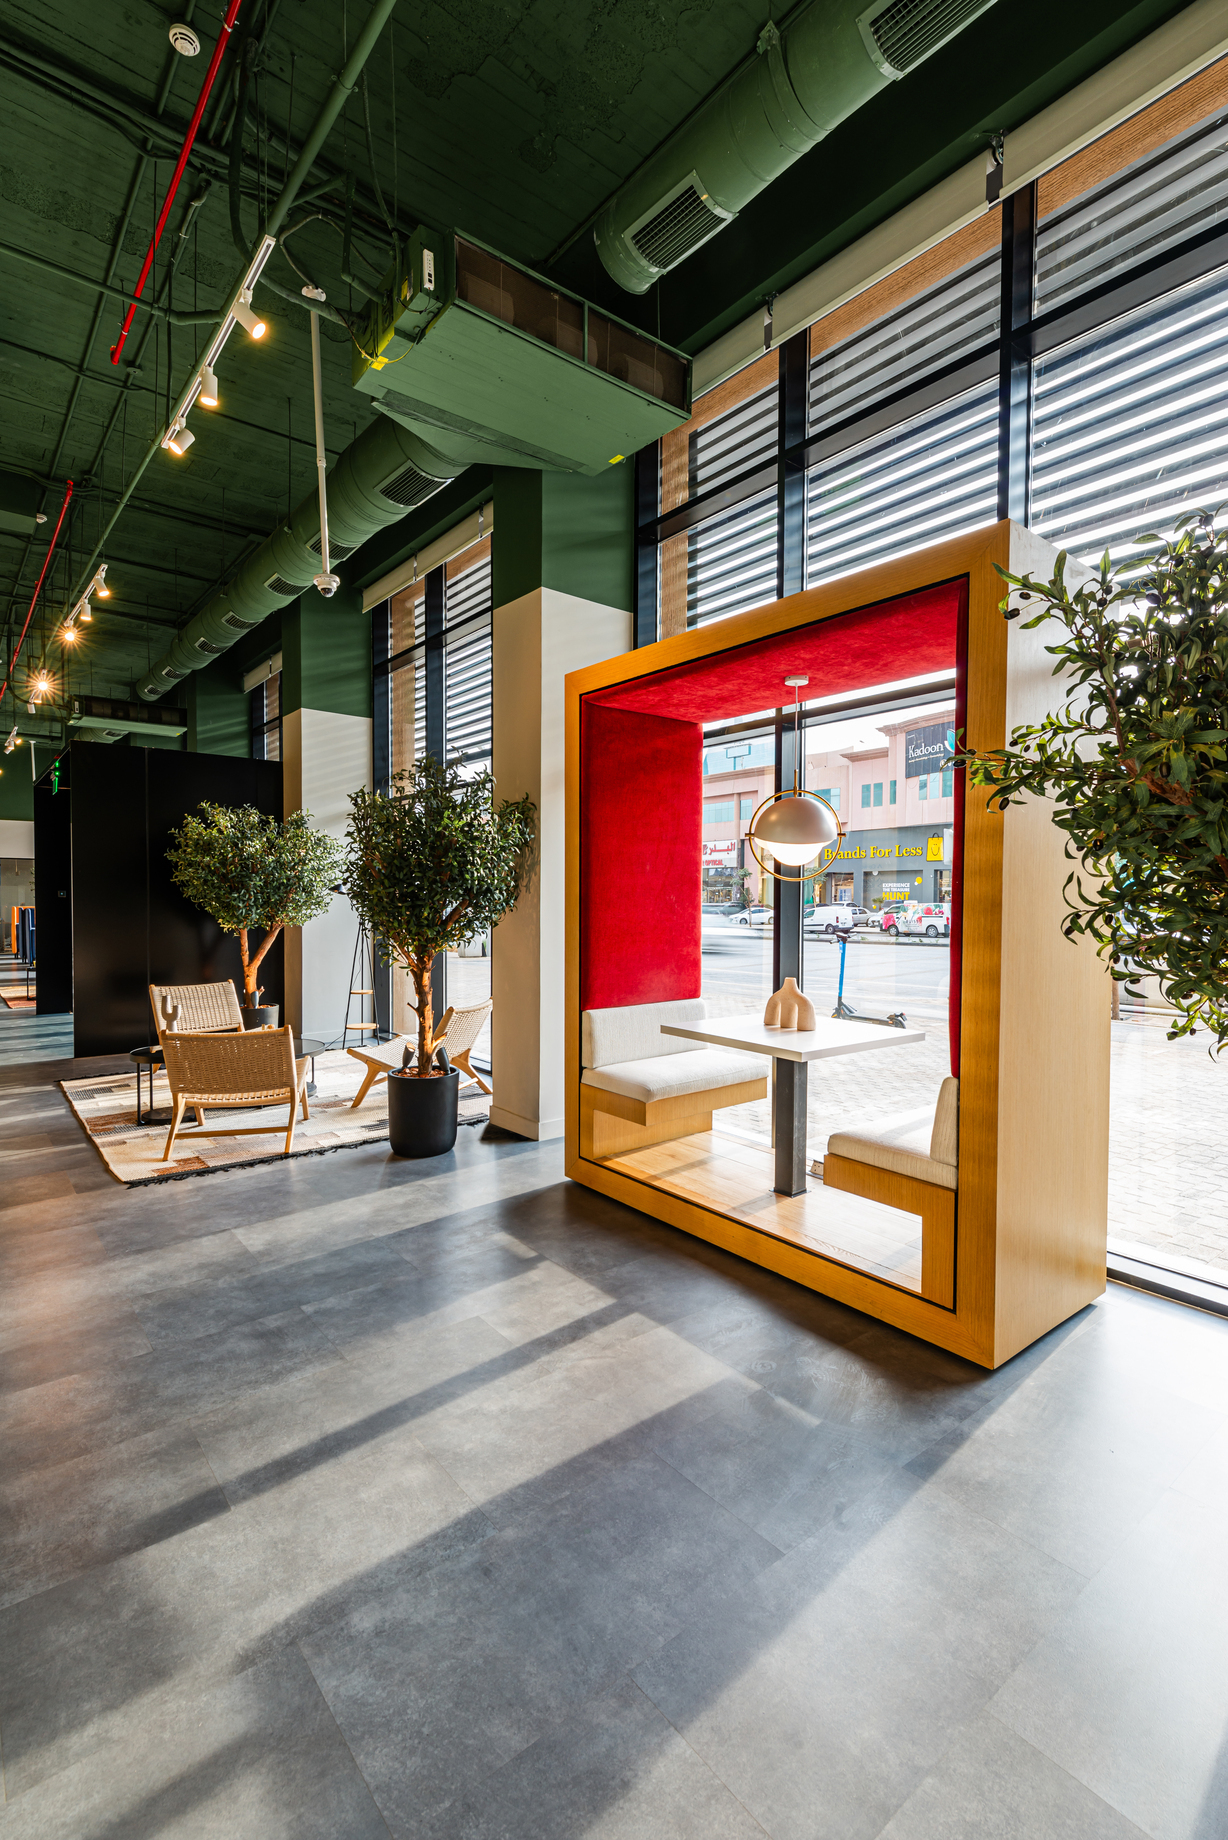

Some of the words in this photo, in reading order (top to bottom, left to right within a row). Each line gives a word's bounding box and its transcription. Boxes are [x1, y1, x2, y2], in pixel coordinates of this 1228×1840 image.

[908, 743, 944, 758] Kadoon
[870, 846, 892, 858] For
[895, 844, 923, 857] Less
[882, 892, 910, 900] HUNT
